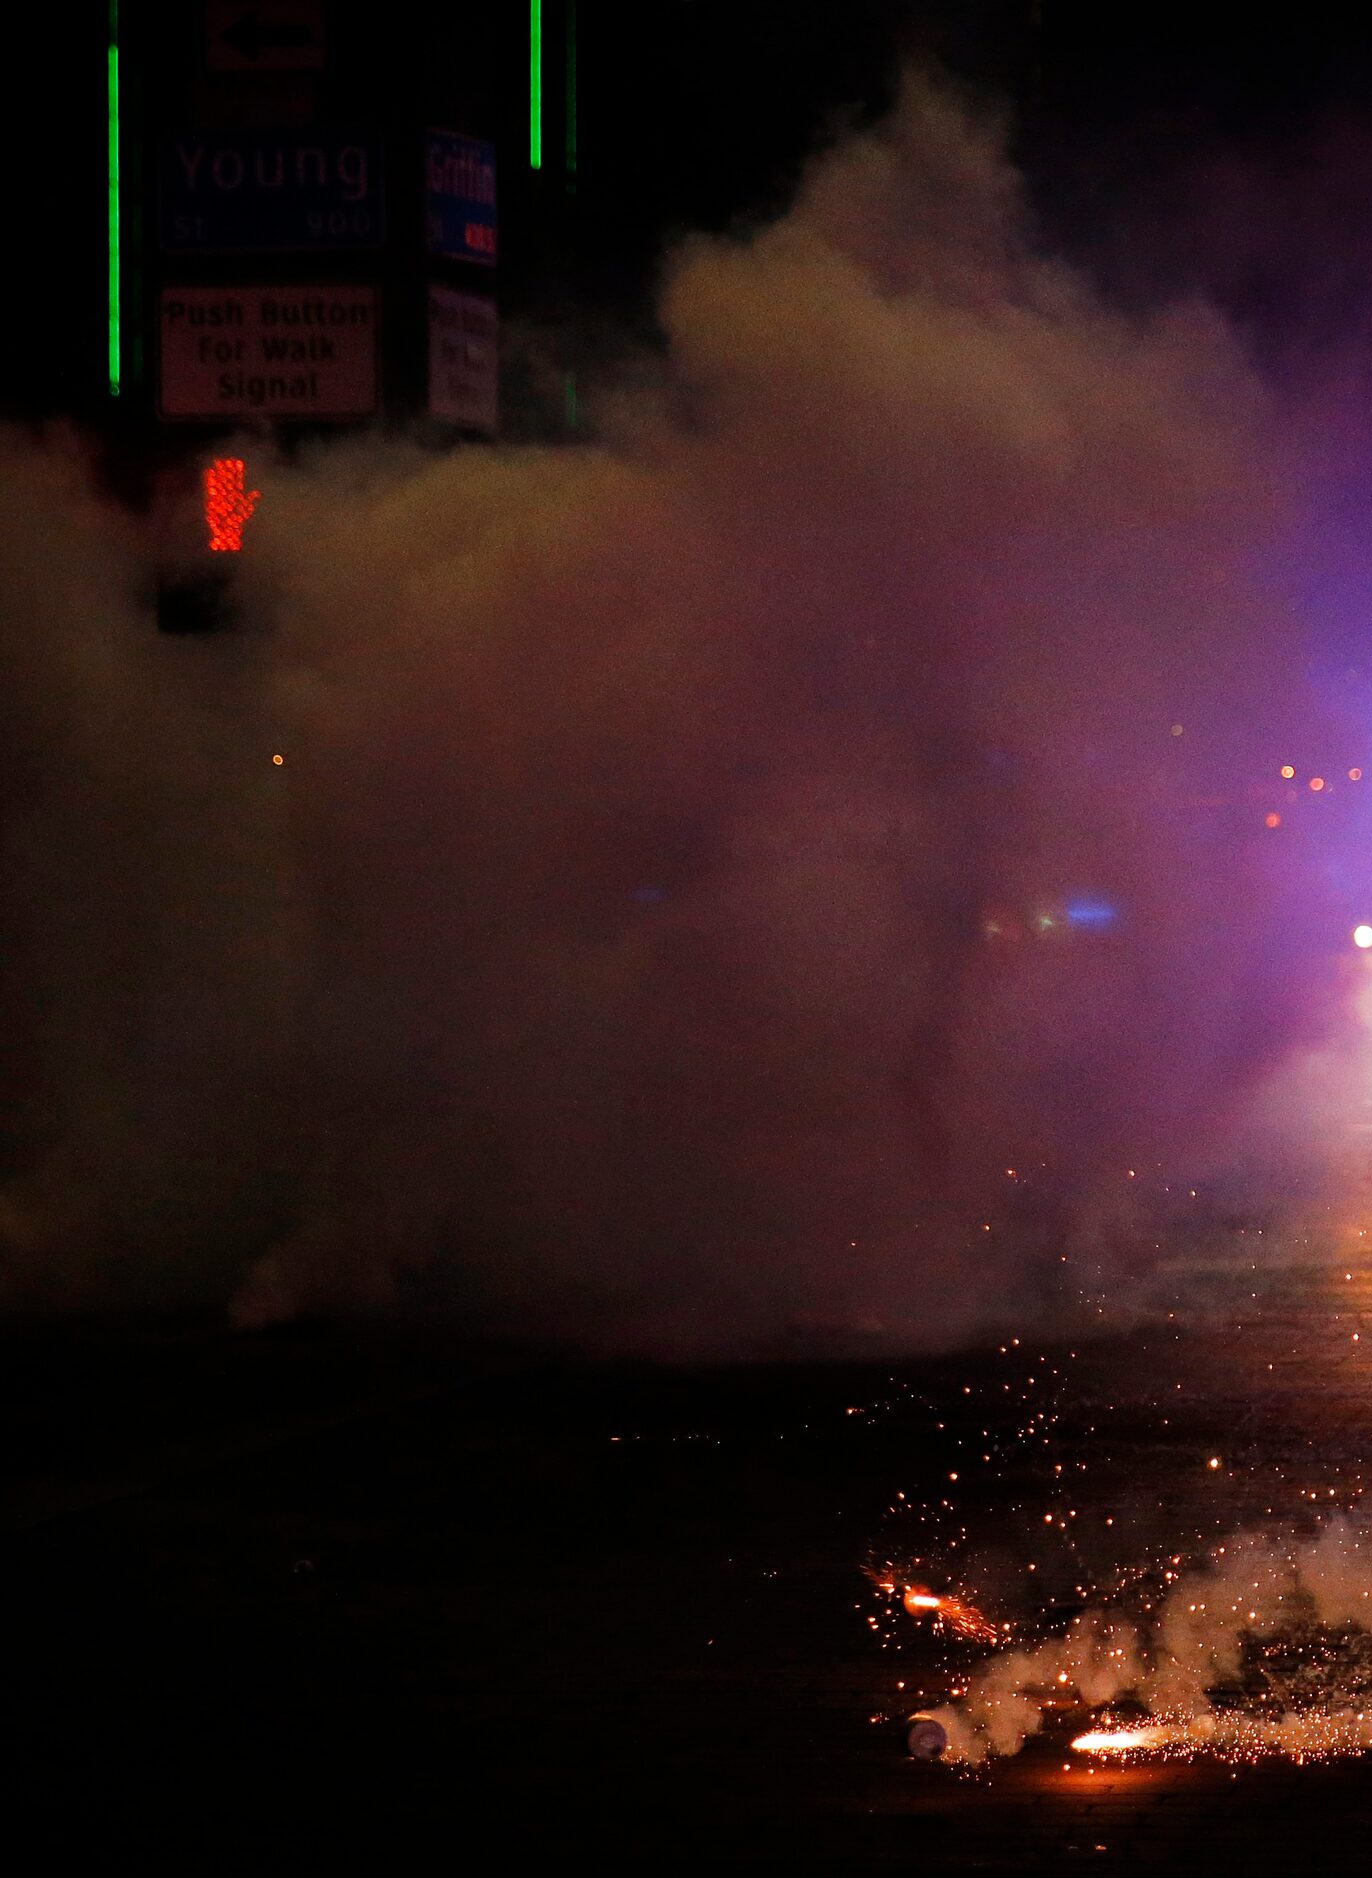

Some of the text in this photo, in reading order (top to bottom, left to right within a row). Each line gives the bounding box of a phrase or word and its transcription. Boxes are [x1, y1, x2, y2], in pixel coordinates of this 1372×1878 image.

[176, 144, 368, 201] Young
[304, 208, 373, 240] 900
[167, 299, 369, 326] Push Button
[198, 336, 334, 362] For Walk
[219, 371, 317, 406] Signal
